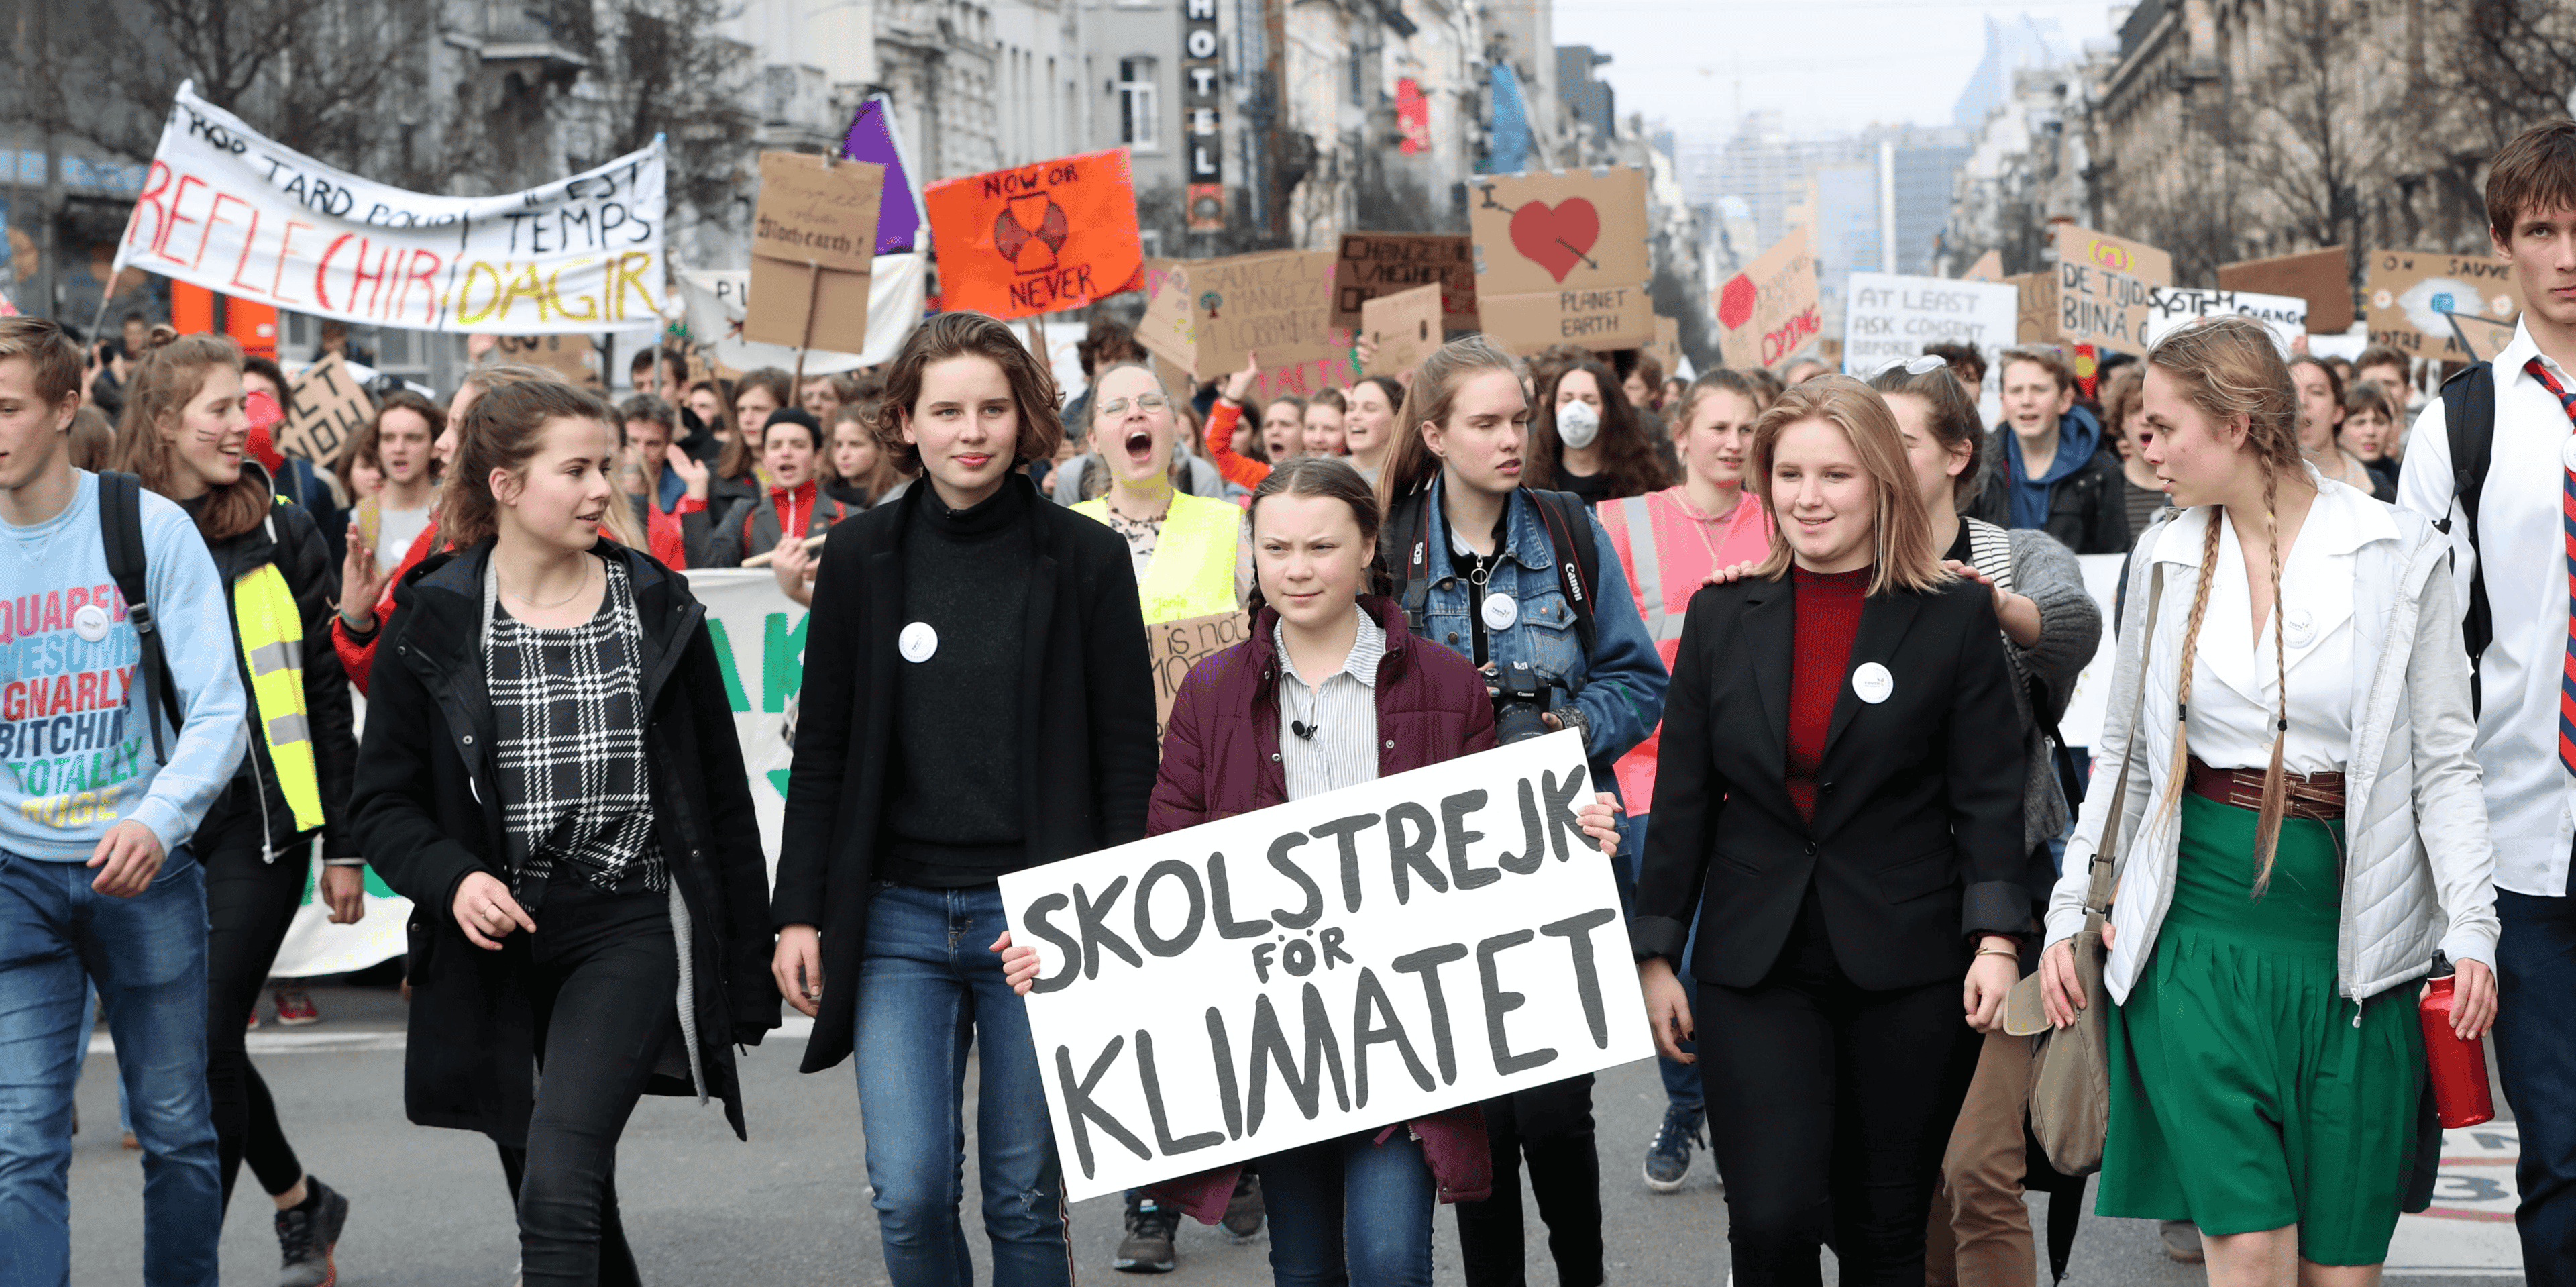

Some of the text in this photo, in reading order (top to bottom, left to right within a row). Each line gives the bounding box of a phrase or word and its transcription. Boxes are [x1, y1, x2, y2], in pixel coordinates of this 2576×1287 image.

[1188, 0, 1218, 175] HOTEL
[263, 154, 354, 218] TARD
[983, 162, 1079, 199] NOW OR
[1479, 183, 1497, 209] I
[128, 158, 441, 323] REFLECHIR
[503, 202, 651, 254] TEMPS
[456, 250, 661, 325] D'AGIR
[1008, 263, 1098, 311] NEVER
[2063, 262, 2145, 308] DE TIJD
[2446, 258, 2510, 282] SAUVE
[1560, 289, 1629, 312] PLANET
[1856, 287, 1980, 313] AT LEAST
[2063, 295, 2130, 343] BIJNA
[2147, 286, 2235, 318] SYSTEM
[1560, 315, 1619, 338] EARTH
[1760, 302, 1821, 366] DYING
[1851, 340, 1914, 356] BEFORE
[1852, 315, 1986, 338] ASK CONSENT
[1413, 541, 1423, 564] EOS
[1565, 562, 1583, 601] Canon
[1164, 625, 1189, 655] is
[1197, 611, 1250, 648] not
[3, 665, 137, 721] GNARLY
[8, 736, 143, 796] TOTALLY
[1023, 764, 1602, 994] SKOLSTREJK
[1252, 925, 1354, 983] FÖR
[1056, 907, 1617, 1180] KLIMATET
